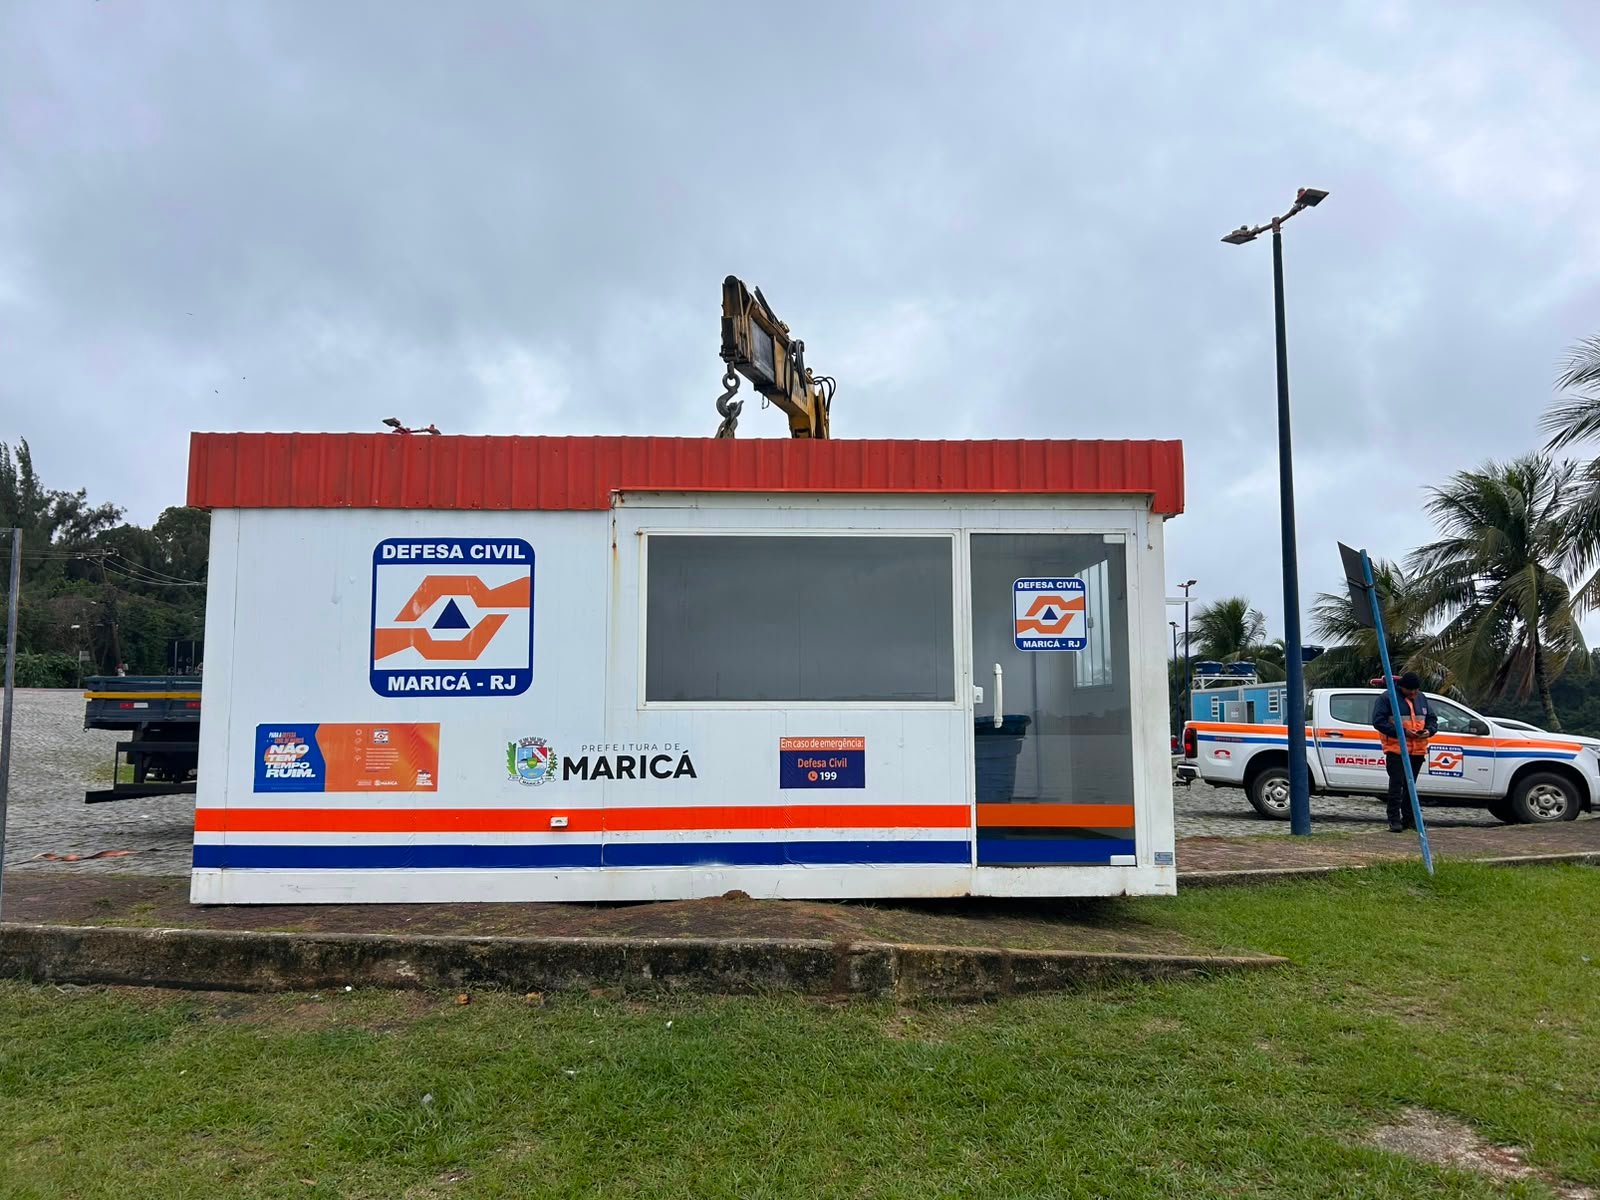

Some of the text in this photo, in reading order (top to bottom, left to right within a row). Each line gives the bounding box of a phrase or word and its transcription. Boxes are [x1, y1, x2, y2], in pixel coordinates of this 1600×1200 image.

[382, 544, 526, 559] DEFESA CIVIL
[1017, 581, 1082, 589] DEFESA CIVIL
[1023, 639, 1060, 648] MARICÁ
[1068, 640, 1080, 648] RJ
[388, 672, 471, 691] MARICÁ
[490, 675, 516, 690] RJ
[269, 742, 310, 754] NÃO
[581, 743, 658, 752] PREFEITURA
[780, 738, 864, 750] Em caso de emergência:
[268, 754, 297, 762] TEM
[797, 758, 848, 768] Defesa Civil
[1335, 756, 1386, 766] MARICÁ
[562, 750, 698, 781] MARICÁ
[265, 768, 316, 778] RUIM.
[820, 771, 838, 781] 199
